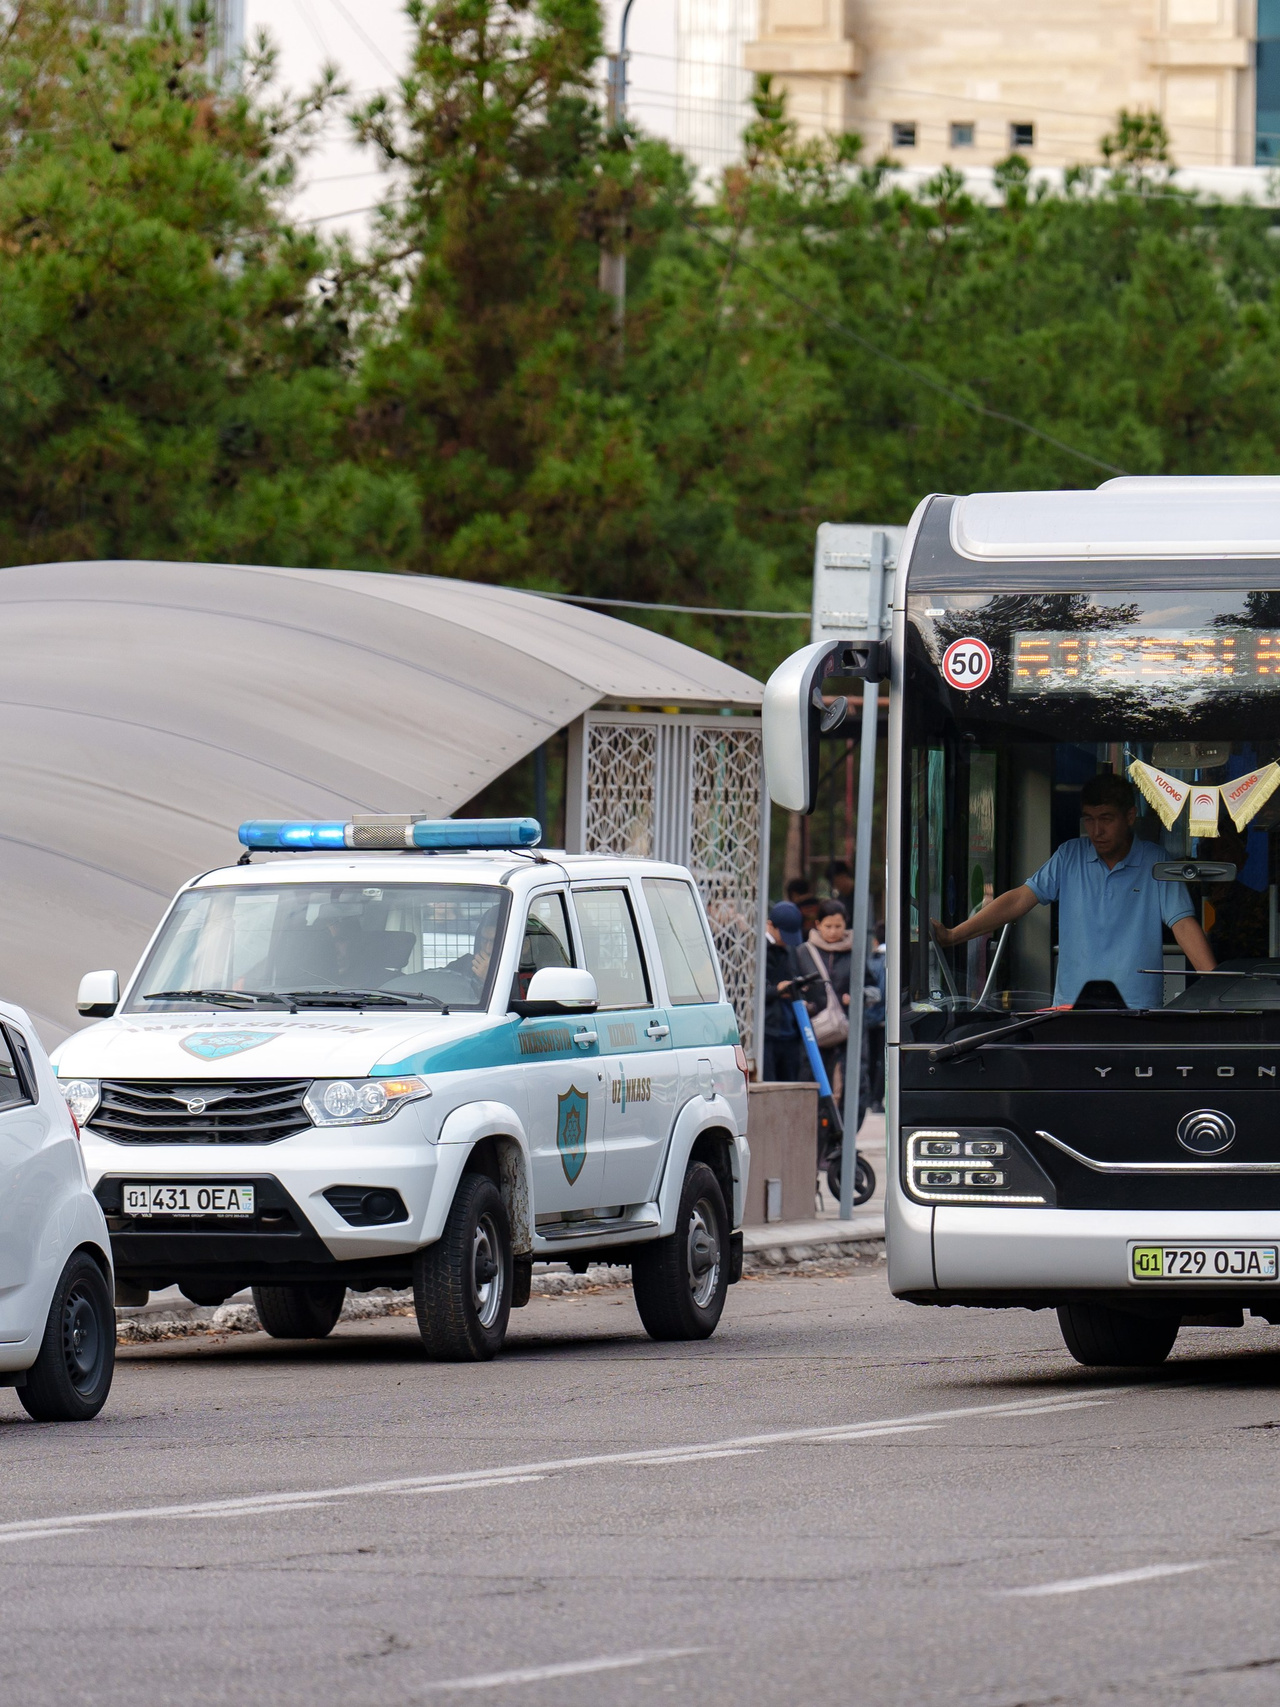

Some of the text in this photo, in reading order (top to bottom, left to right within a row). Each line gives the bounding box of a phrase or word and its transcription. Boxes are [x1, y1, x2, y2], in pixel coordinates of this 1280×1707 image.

[952, 652, 983, 676] 50
[1154, 775, 1182, 802] YUTONG
[1229, 774, 1258, 801] YUTONG
[518, 1028, 572, 1055] INKASSATSIYA
[129, 1189, 240, 1210] 01 431 OEA
[1140, 1251, 1261, 1274] 01 729 OJA
[1263, 1265, 1274, 1274] UZ
